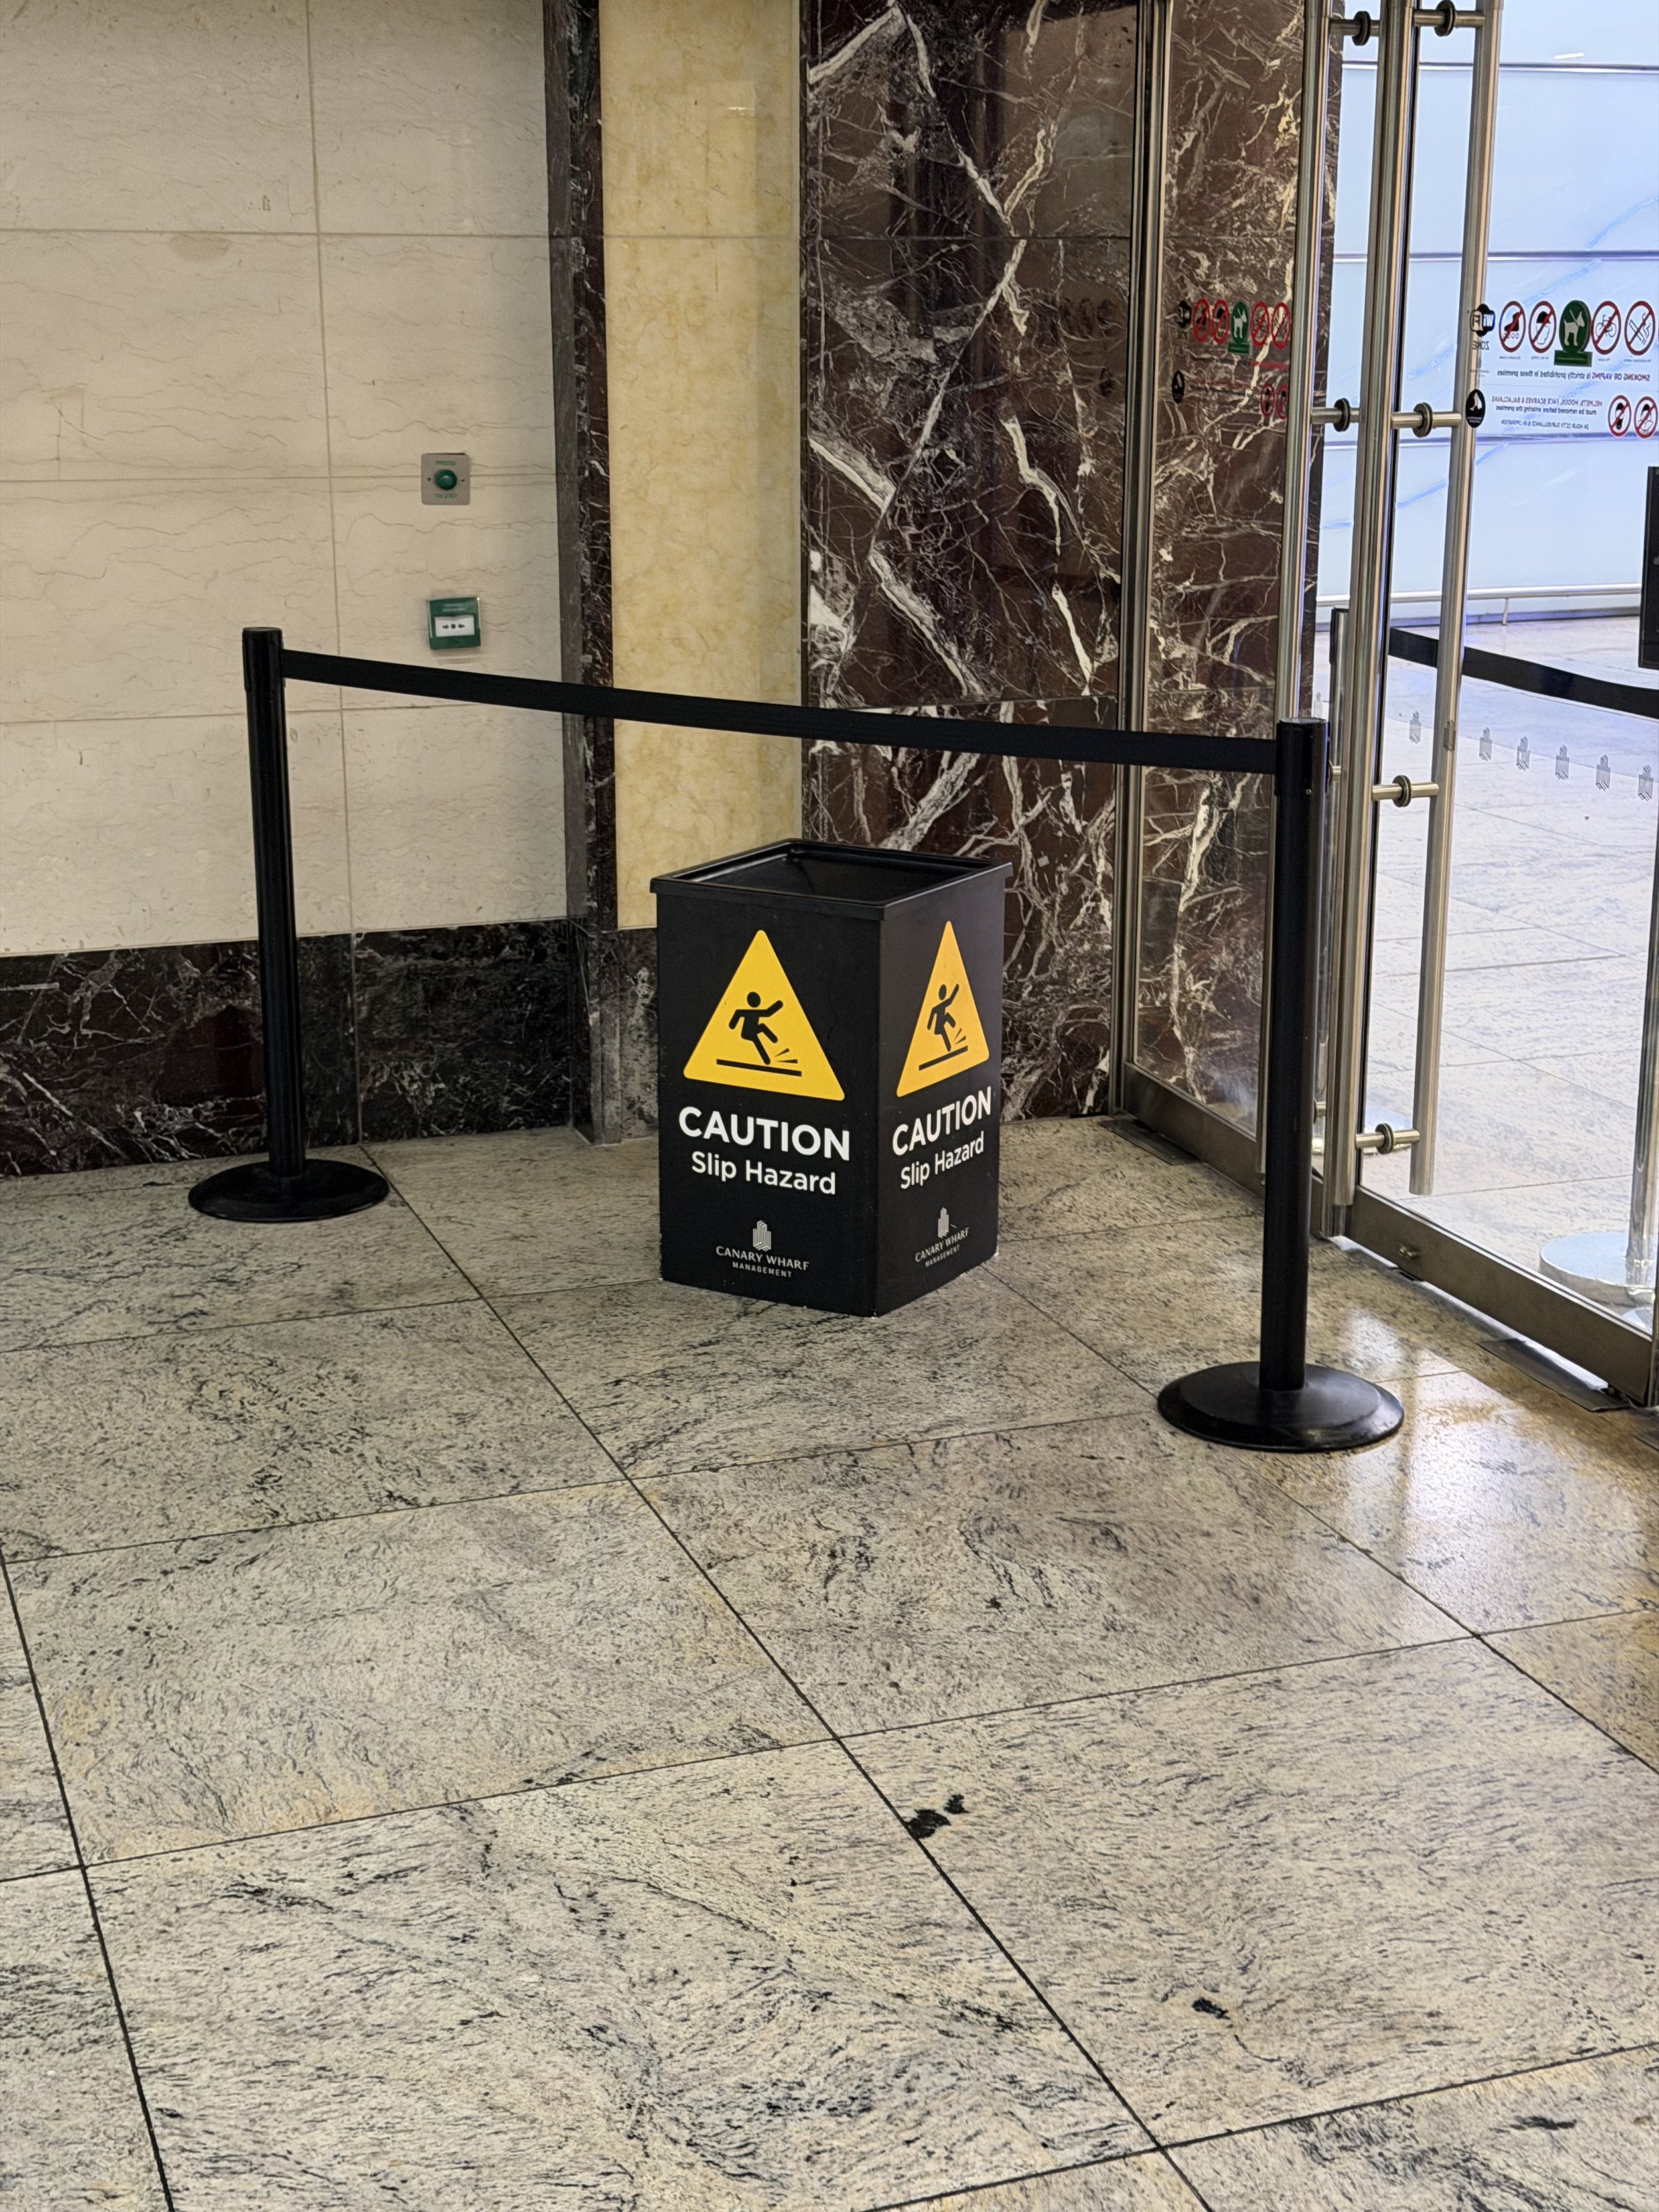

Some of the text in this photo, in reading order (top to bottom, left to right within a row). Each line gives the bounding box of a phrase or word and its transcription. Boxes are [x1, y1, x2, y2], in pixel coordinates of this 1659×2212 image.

[678, 1106, 851, 1161] CAUTION
[892, 1086, 991, 1156] CAUTION
[691, 1151, 835, 1195] Slip Hazard
[901, 1130, 984, 1189] Slip Hazard
[715, 1245, 810, 1271] CANARY WHARF
[914, 1226, 970, 1262] CANARY WHARF
[924, 1244, 960, 1268] MANAGEMENT
[732, 1261, 792, 1278] MANAGEMENT
